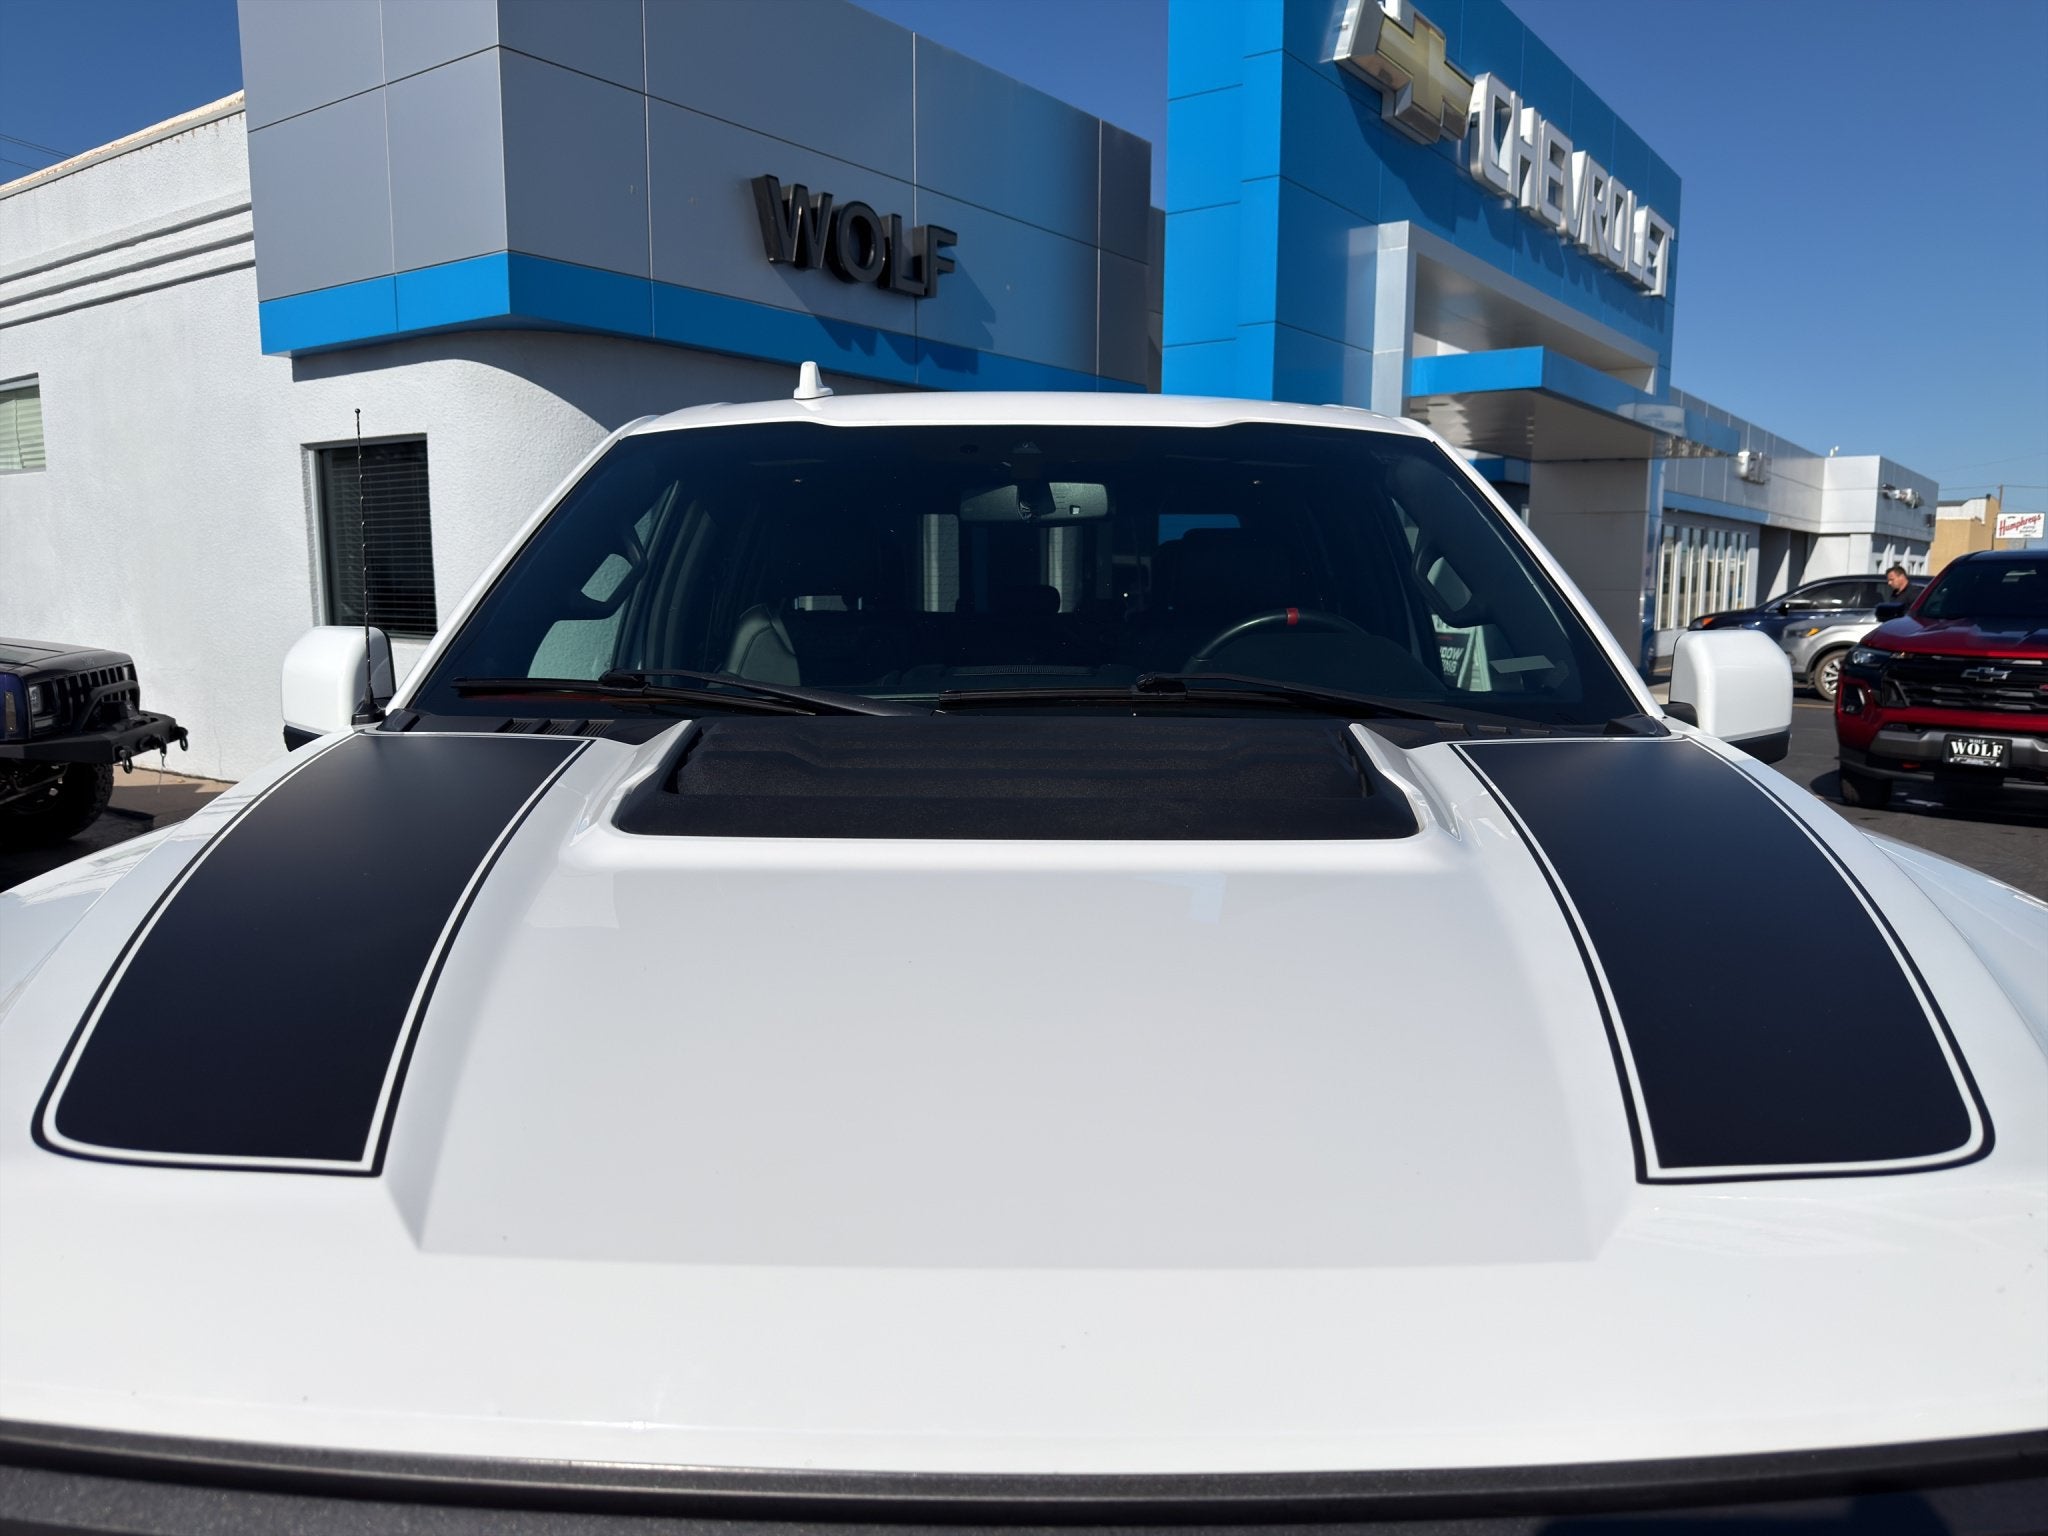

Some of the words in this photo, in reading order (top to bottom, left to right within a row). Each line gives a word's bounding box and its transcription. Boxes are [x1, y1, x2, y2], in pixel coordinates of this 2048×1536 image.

[1469, 72, 1674, 297] CHEVROLET
[751, 174, 957, 298] WOLF
[1440, 646, 1464, 660] DOW
[1951, 741, 2003, 757] WOLF
